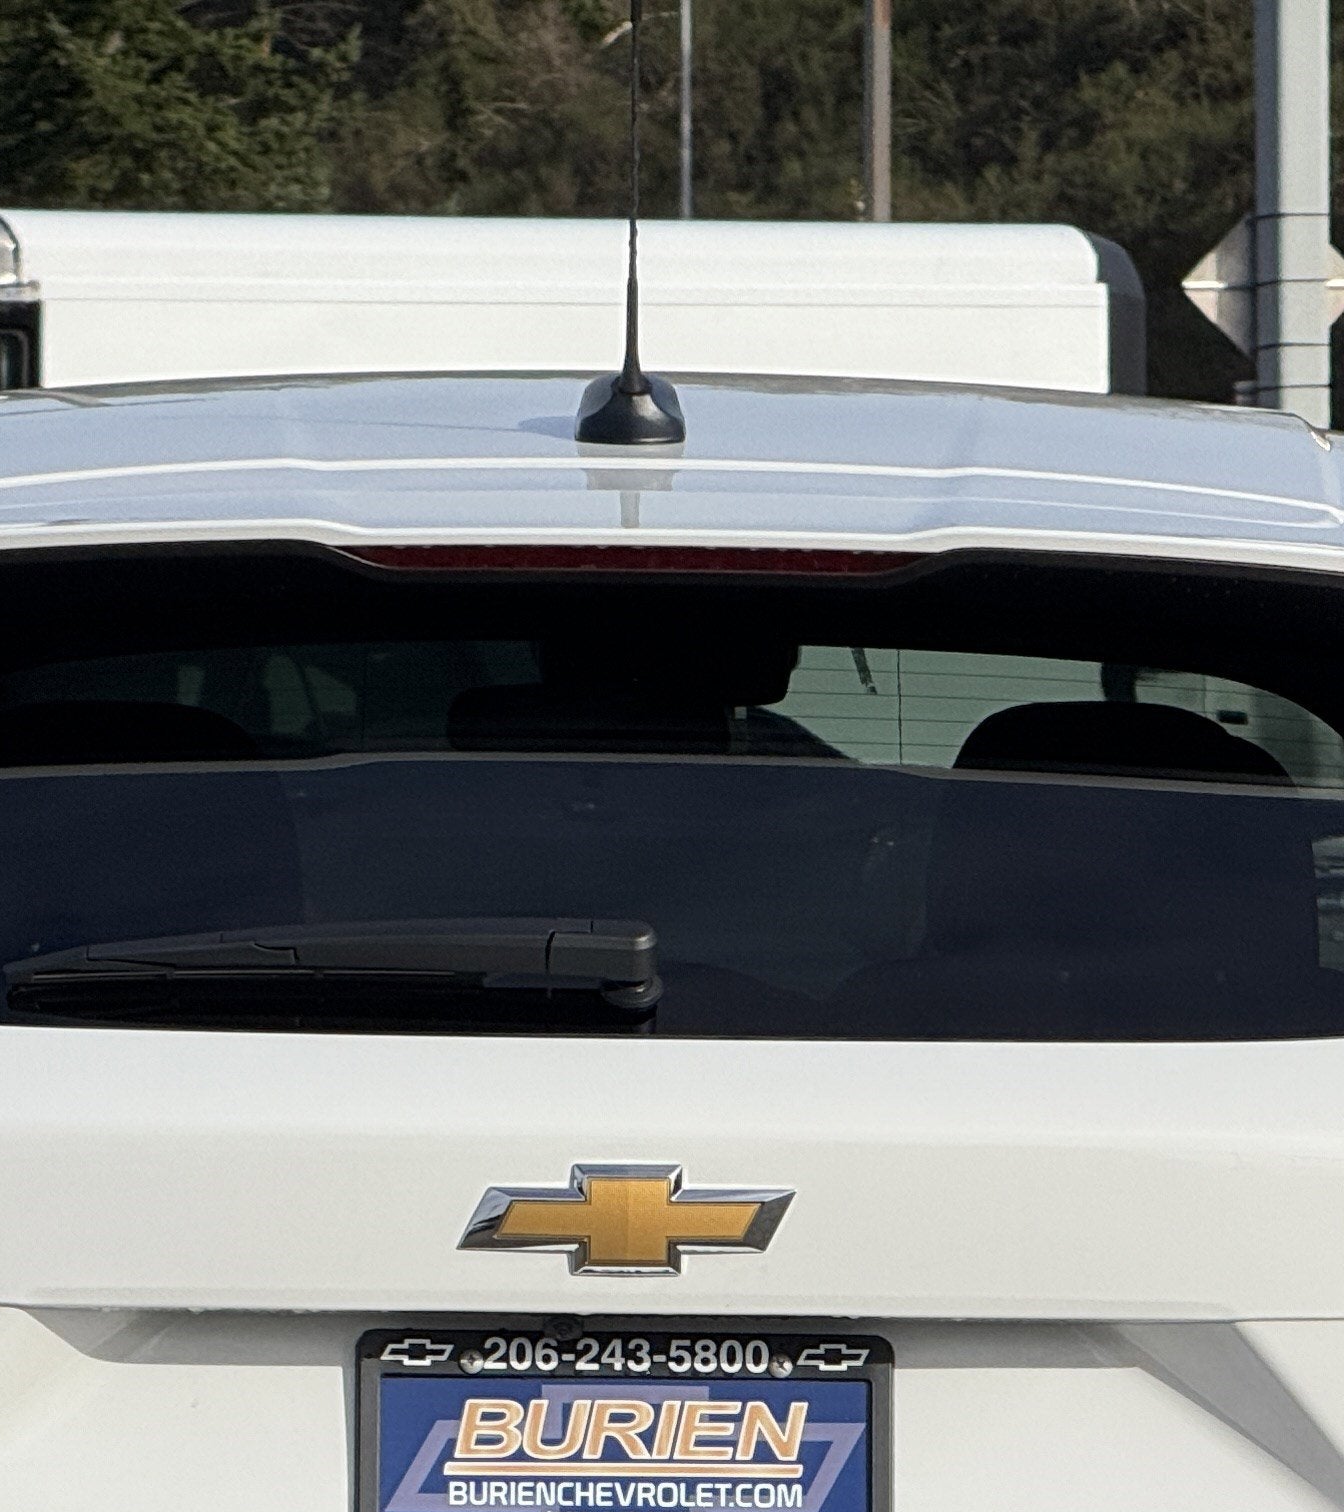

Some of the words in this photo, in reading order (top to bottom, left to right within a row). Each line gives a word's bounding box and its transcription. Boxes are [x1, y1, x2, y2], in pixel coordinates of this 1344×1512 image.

[484, 1337, 770, 1374] 206-243-5800
[454, 1398, 808, 1461] BURIEN
[448, 1481, 803, 1509] BURIENCHEVROLET.COM
